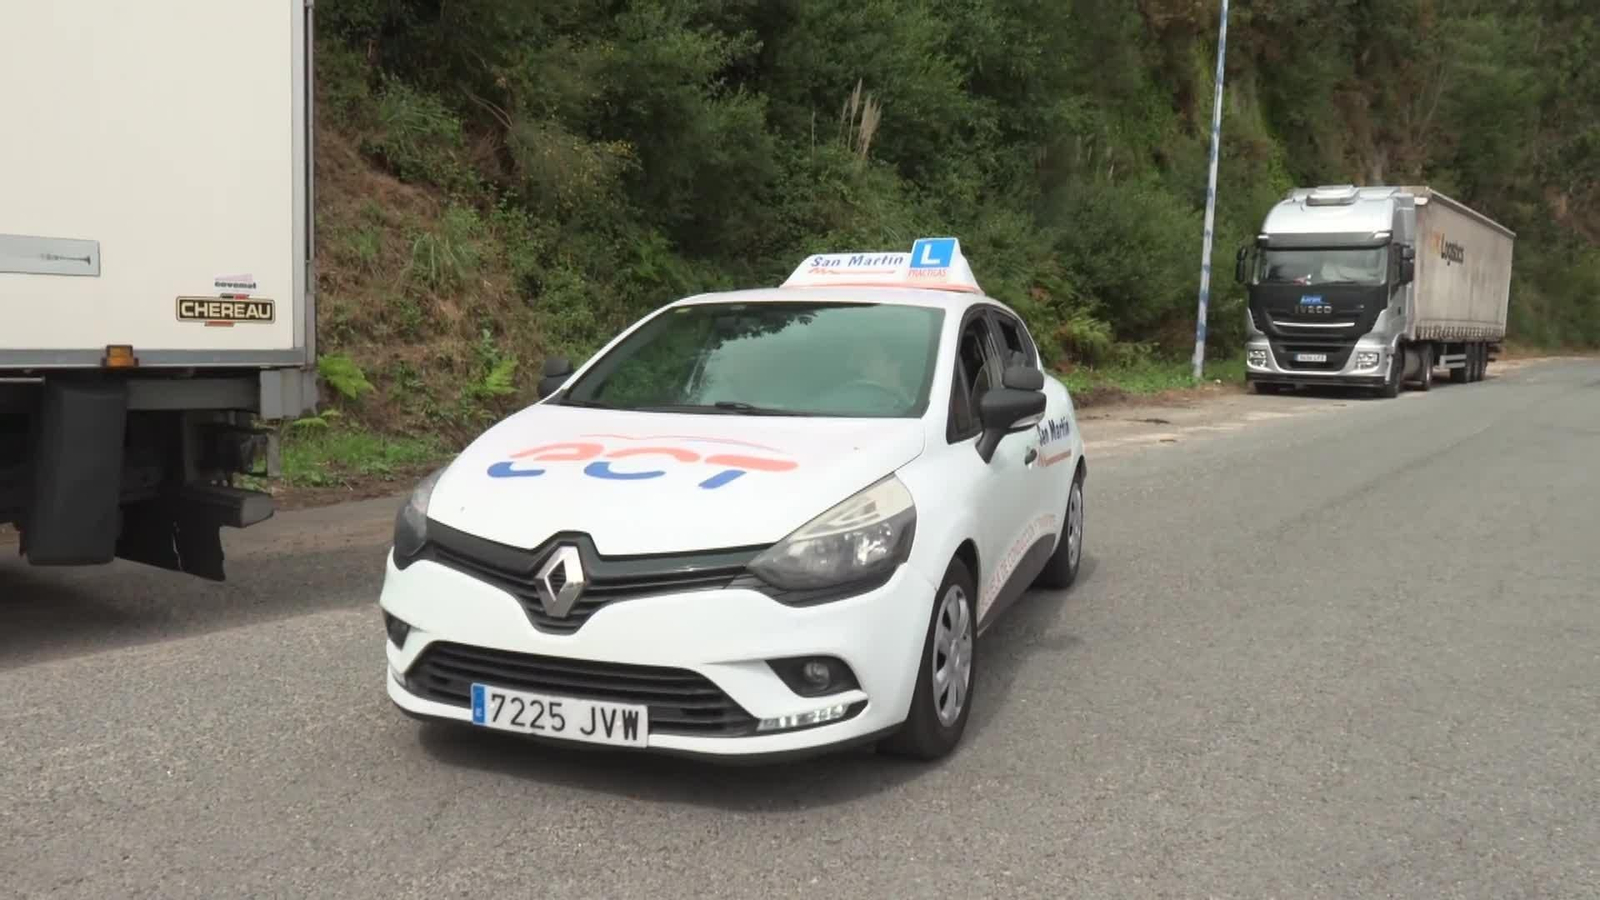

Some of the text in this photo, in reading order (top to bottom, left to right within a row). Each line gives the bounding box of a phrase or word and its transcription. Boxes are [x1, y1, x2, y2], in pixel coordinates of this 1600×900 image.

[920, 243, 941, 265] L
[1440, 232, 1464, 266] Logistics
[811, 256, 841, 267] San
[180, 302, 271, 319] CHEREAU
[1295, 305, 1332, 314] IVECO
[491, 693, 639, 741] 7225 JVW
